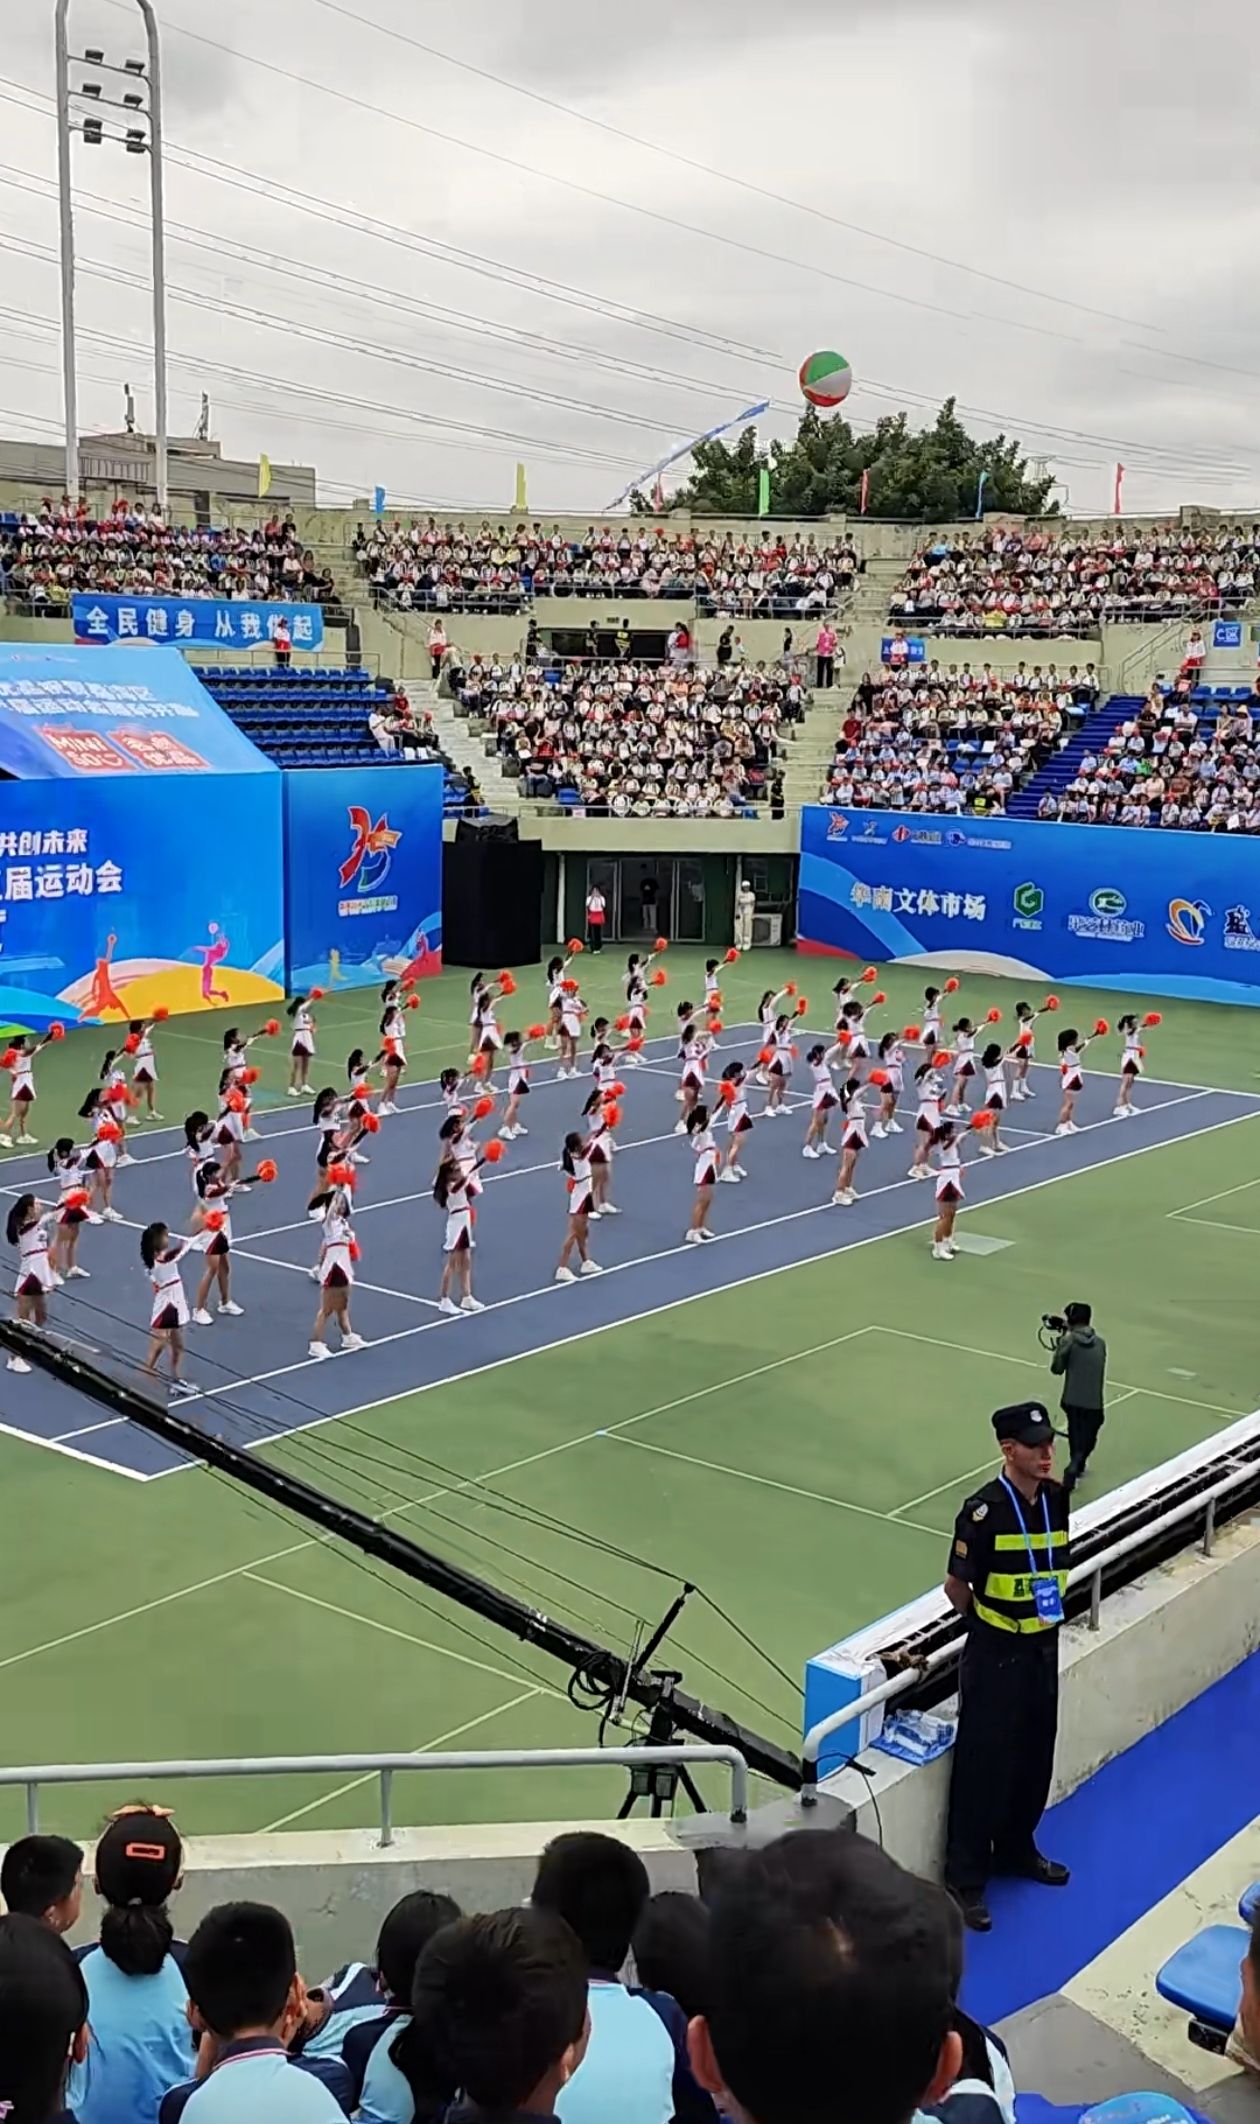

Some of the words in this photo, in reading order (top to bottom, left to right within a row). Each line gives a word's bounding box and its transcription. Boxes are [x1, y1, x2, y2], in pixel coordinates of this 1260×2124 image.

[86, 605, 195, 637] 全民健身
[0, 828, 88, 857] 共创未来
[0, 859, 123, 901] 届运动会
[850, 881, 986, 921] 华南文体市场
